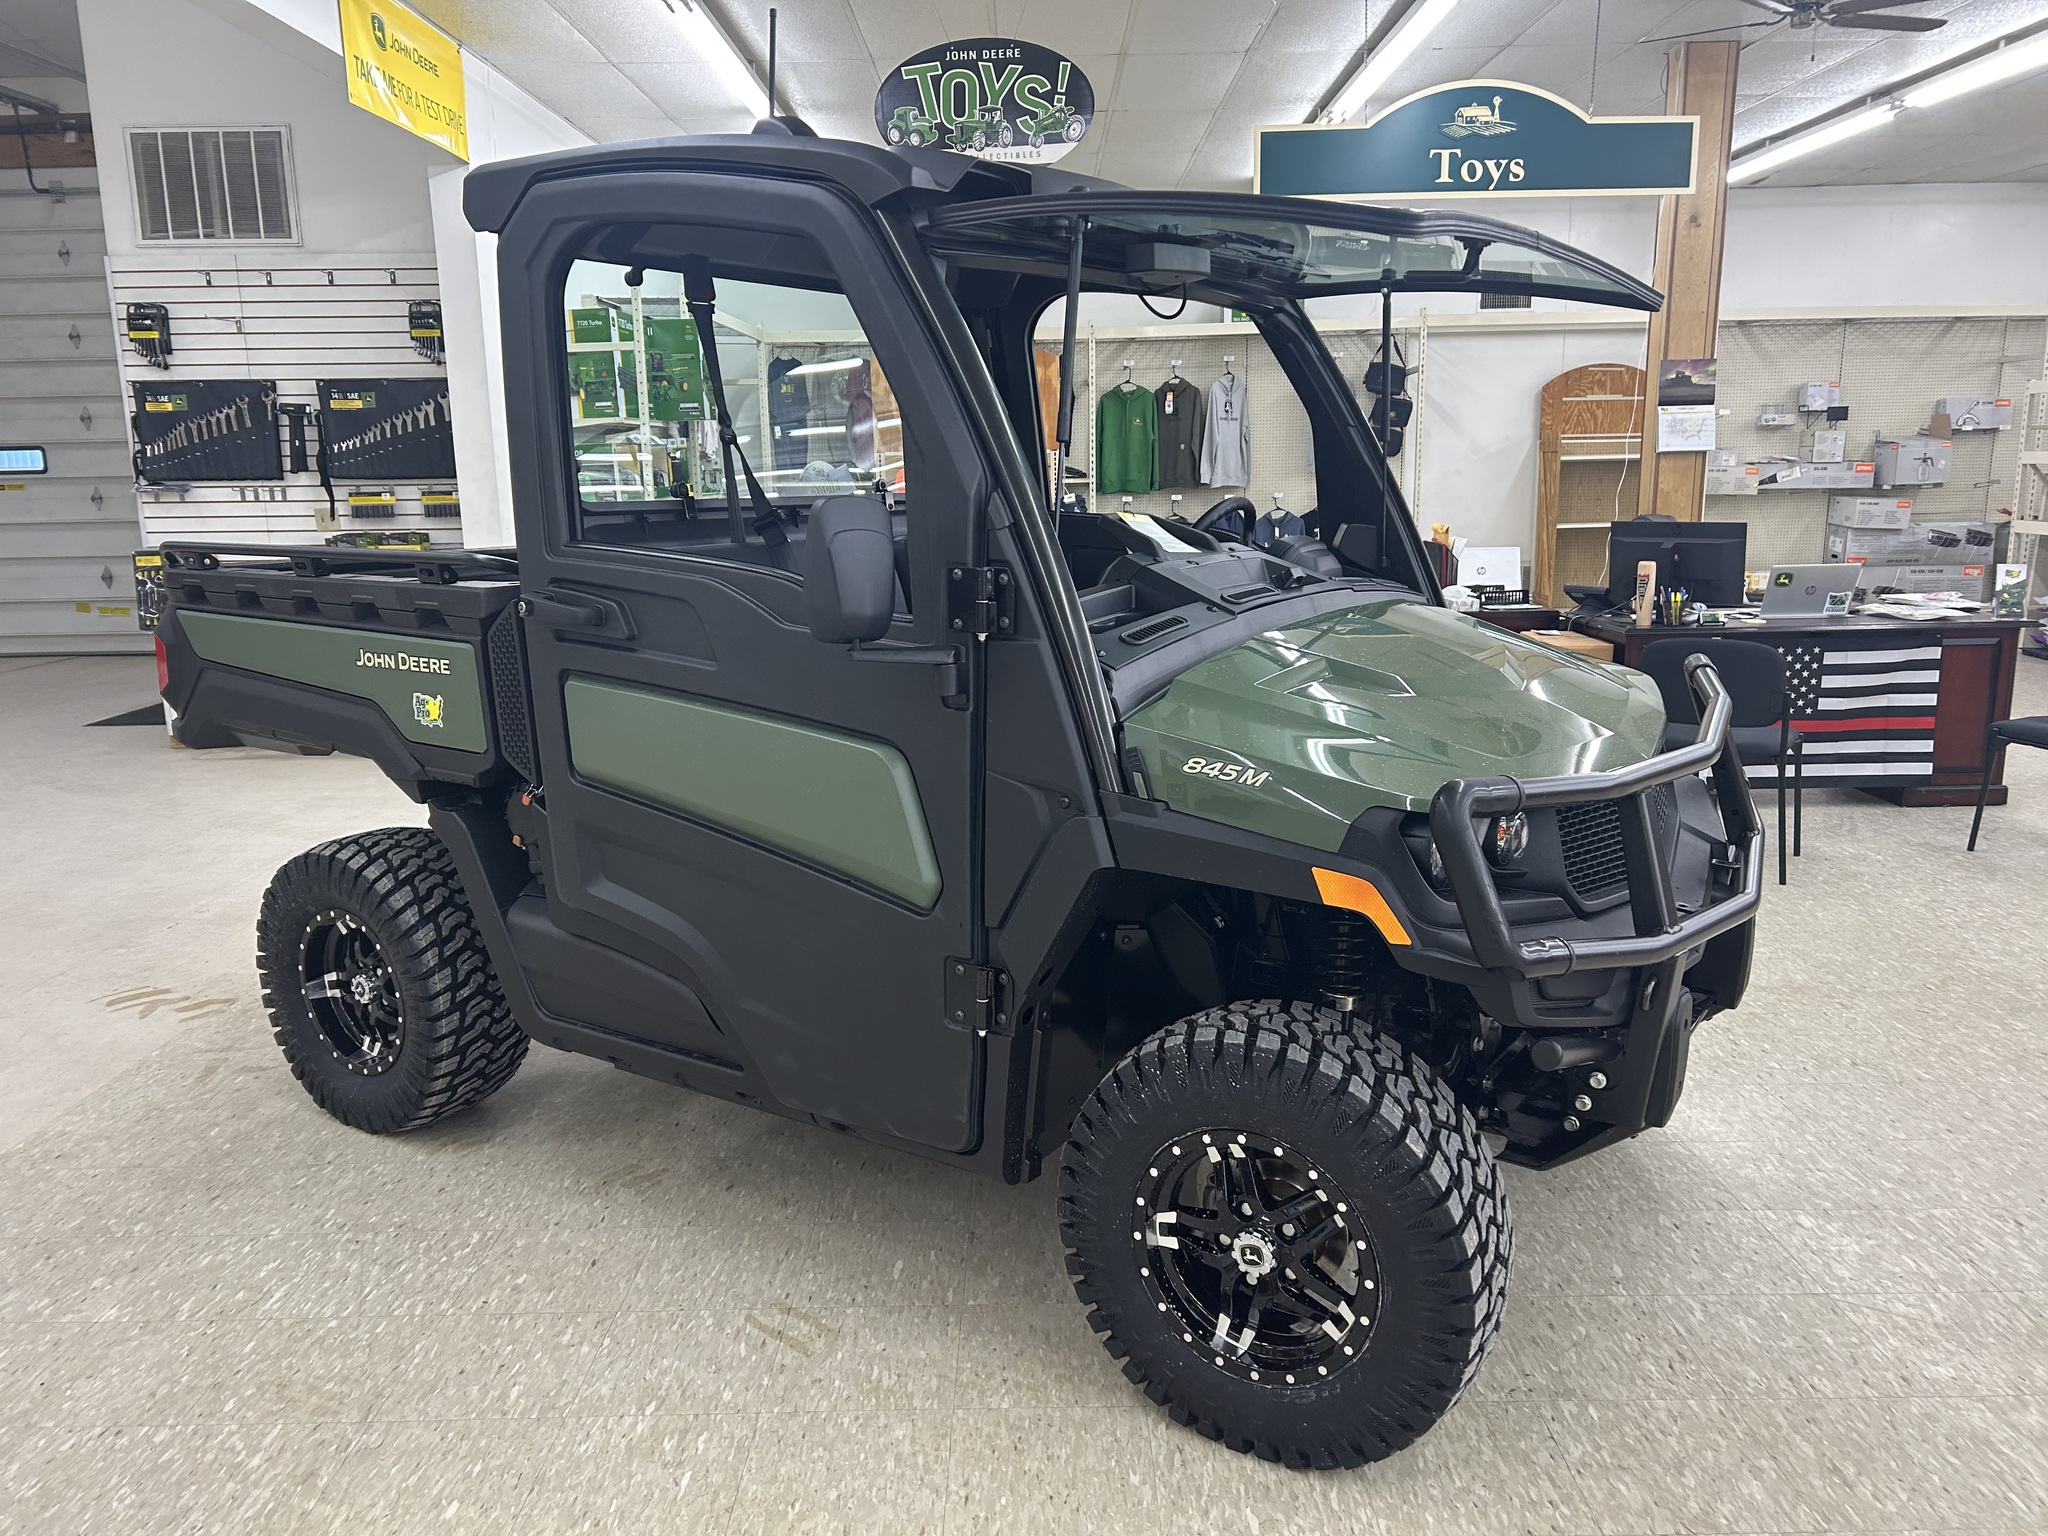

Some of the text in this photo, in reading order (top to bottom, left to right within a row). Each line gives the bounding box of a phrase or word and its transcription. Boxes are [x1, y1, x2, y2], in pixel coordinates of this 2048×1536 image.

[389, 33, 440, 78] JOHN DEERE
[945, 48, 1021, 61] JOHN DEERE
[397, 80, 414, 109] FOR
[415, 91, 422, 113] A
[421, 94, 442, 122] TEST
[442, 106, 464, 136] DRIVE
[901, 61, 1072, 134] TOYS!
[1429, 147, 1526, 191] Toys
[356, 648, 451, 675] JOHN DEERE
[1182, 757, 1270, 787] 845M
